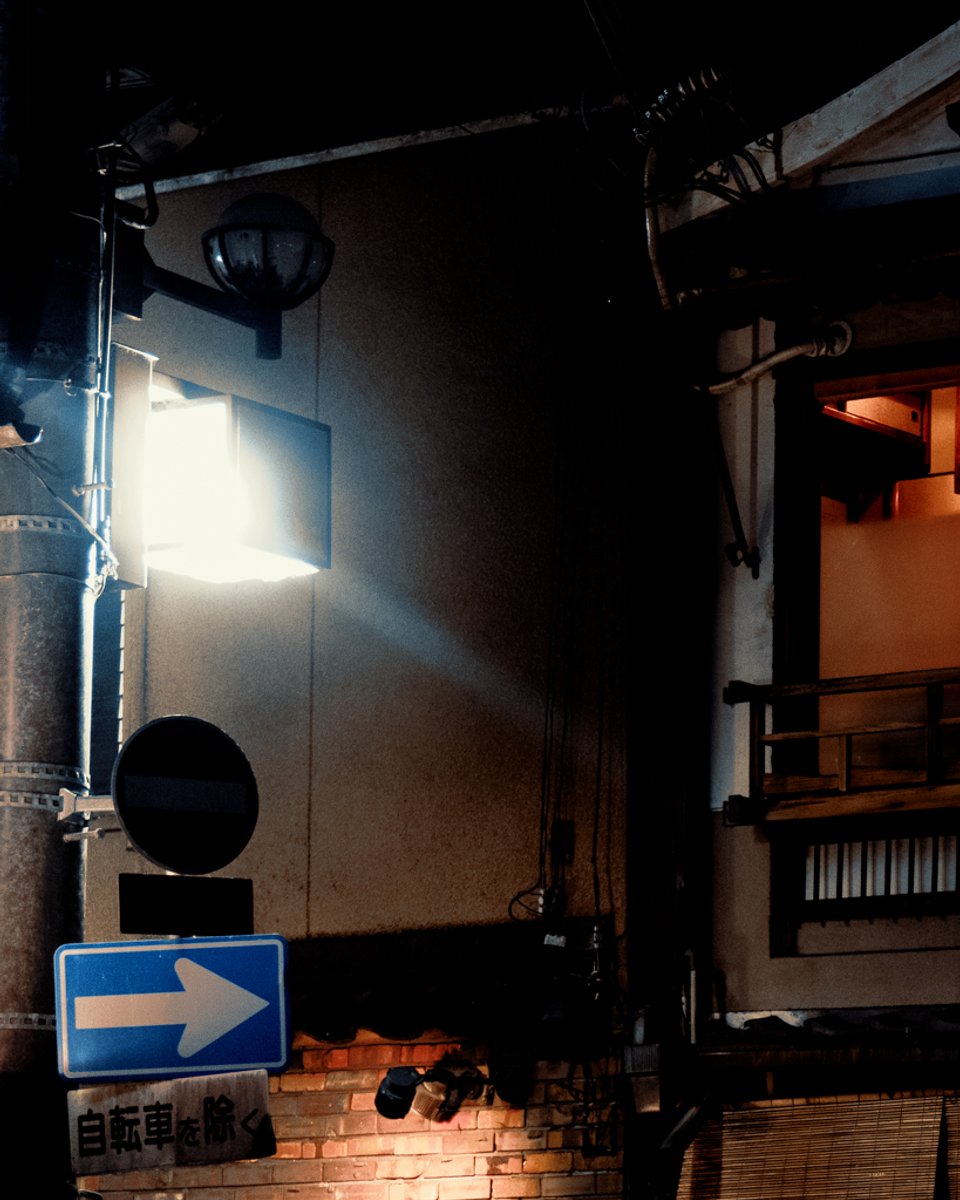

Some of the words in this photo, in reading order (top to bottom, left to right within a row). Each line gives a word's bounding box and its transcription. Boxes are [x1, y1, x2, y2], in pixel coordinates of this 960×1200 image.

[77, 1093, 259, 1157] 自転車を除く
